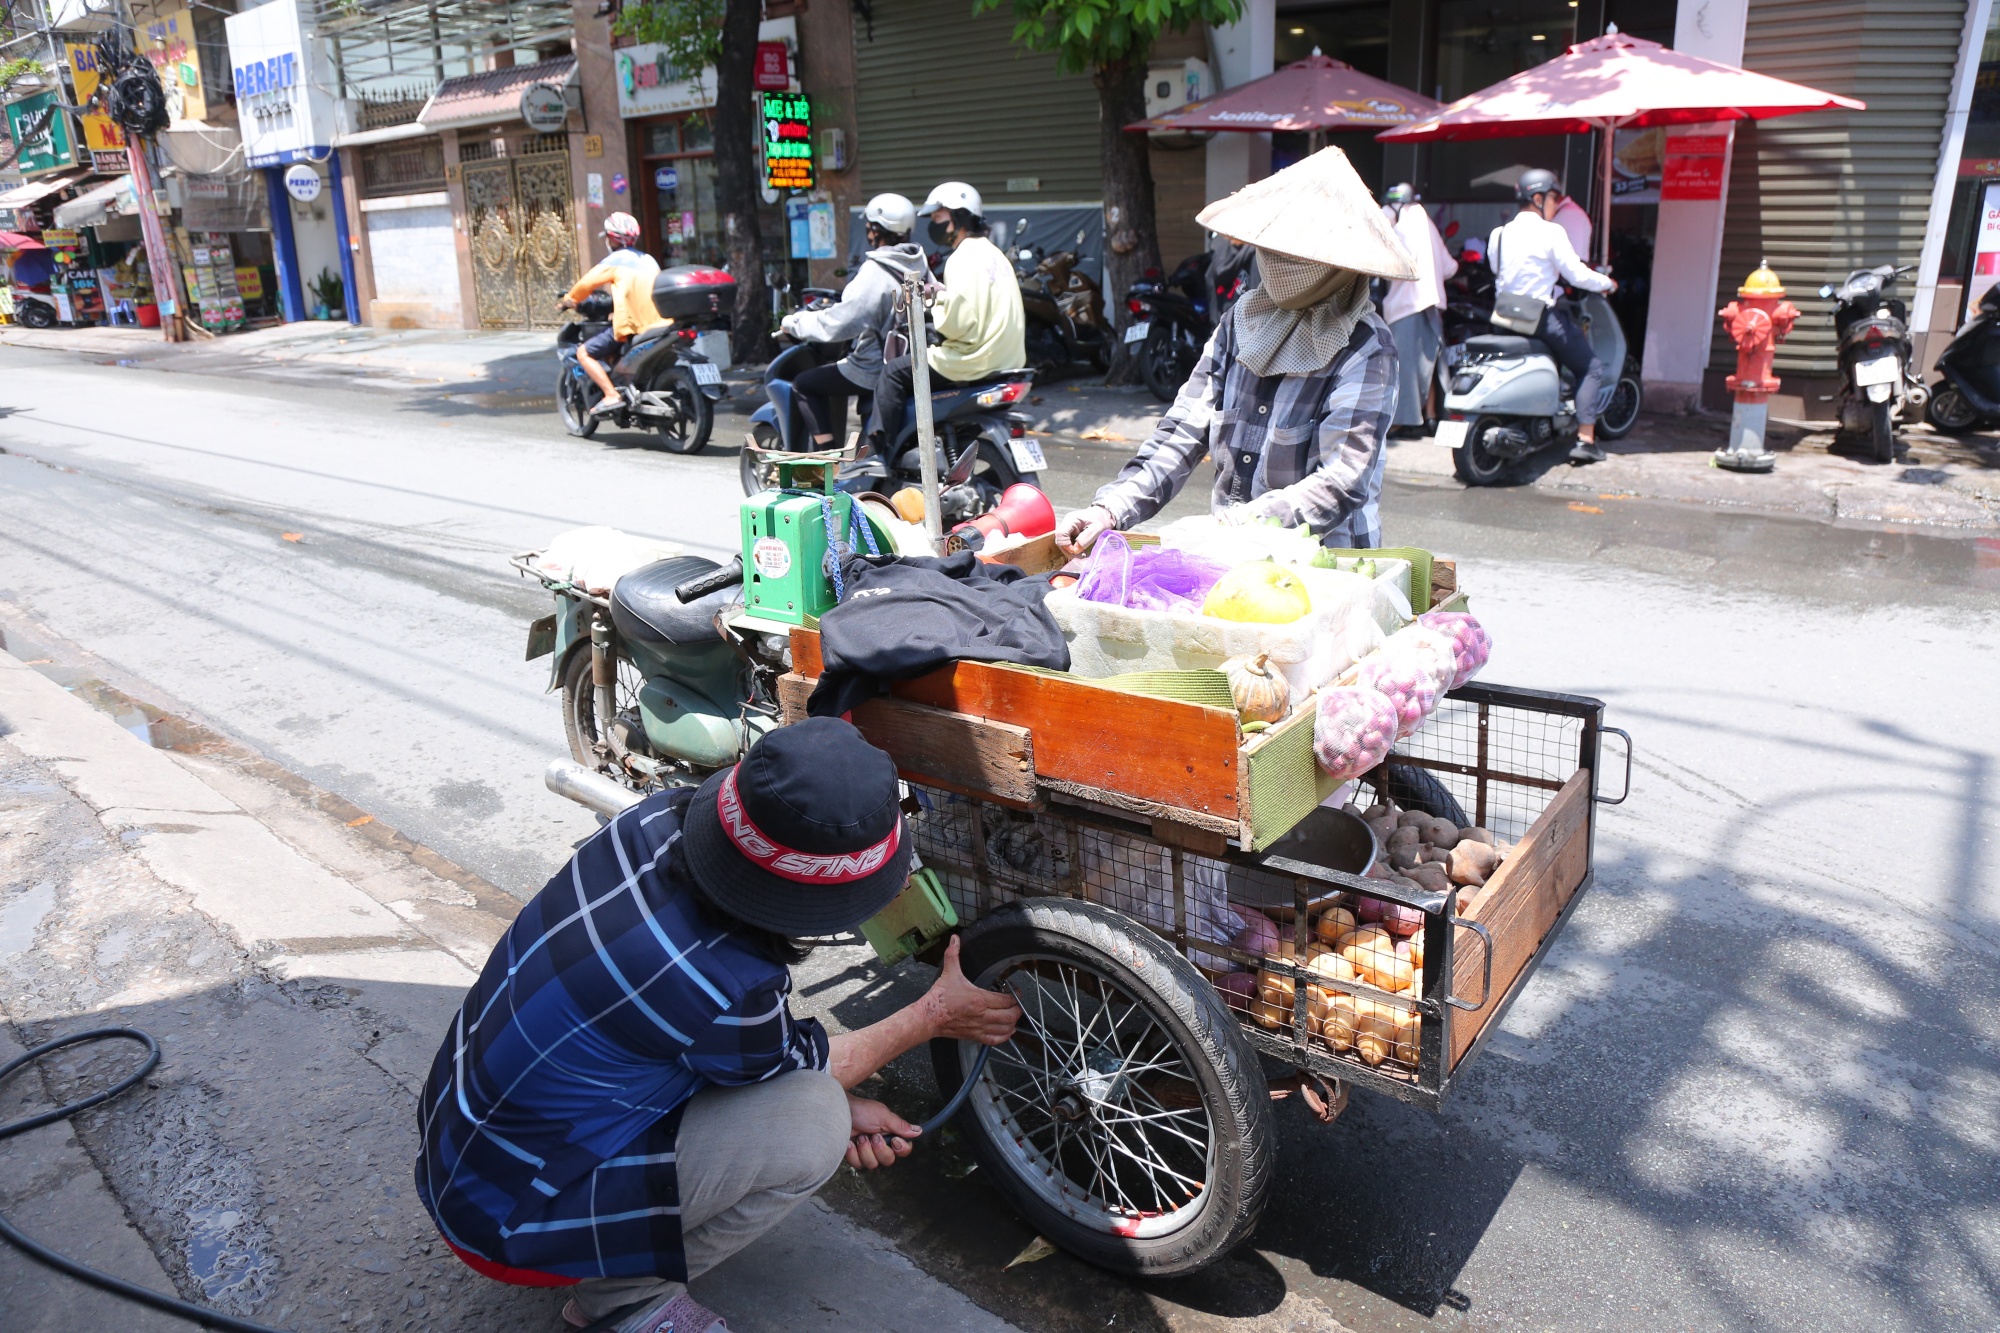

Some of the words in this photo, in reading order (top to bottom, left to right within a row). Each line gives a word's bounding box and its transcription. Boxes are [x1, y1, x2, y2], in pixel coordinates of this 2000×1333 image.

[235, 51, 294, 98] PERFIT
[288, 178, 319, 187] PERFIT
[720, 768, 778, 858] STING
[771, 839, 890, 877] STING
